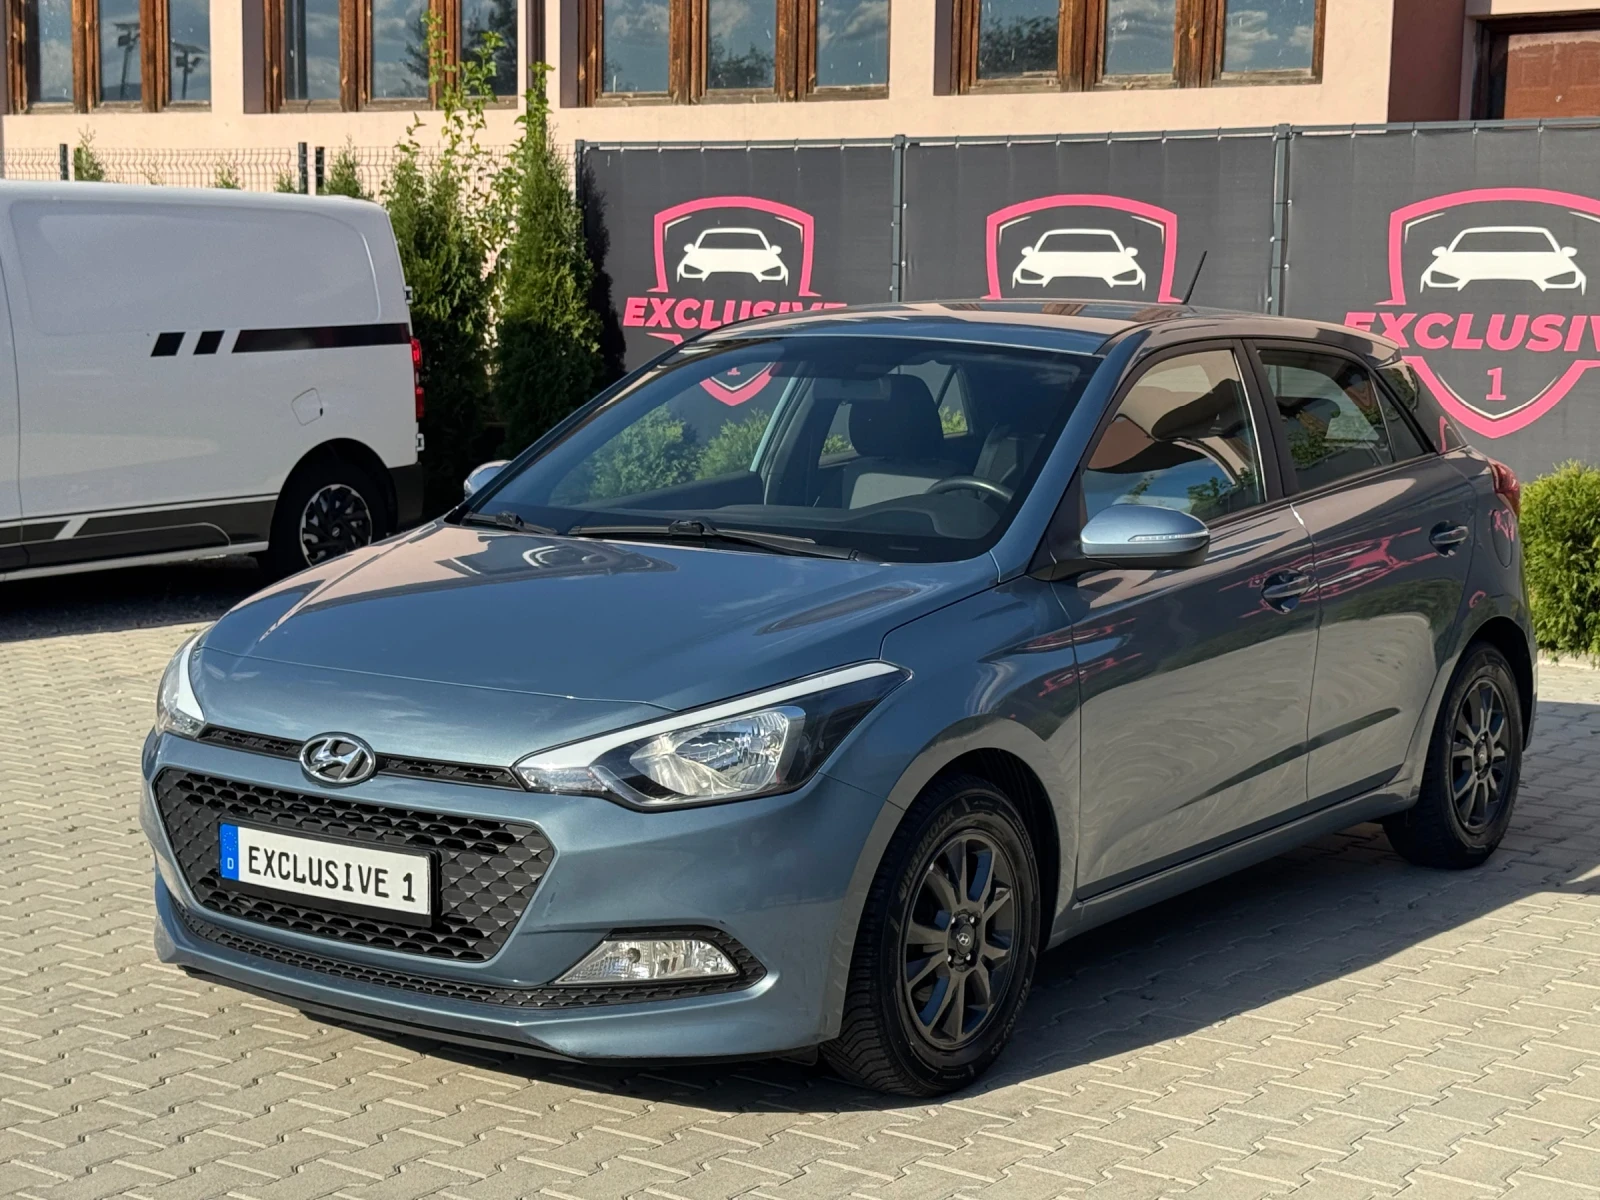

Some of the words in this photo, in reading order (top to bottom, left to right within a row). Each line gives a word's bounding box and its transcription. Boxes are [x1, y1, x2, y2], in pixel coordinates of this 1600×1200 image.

[623, 297, 847, 329] EXCLUS
[1344, 312, 1600, 352] XCLUSI
[1485, 367, 1507, 401] 1
[227, 857, 234, 870] D
[248, 846, 390, 898] EXCLUSIVE
[402, 872, 416, 902] 1
